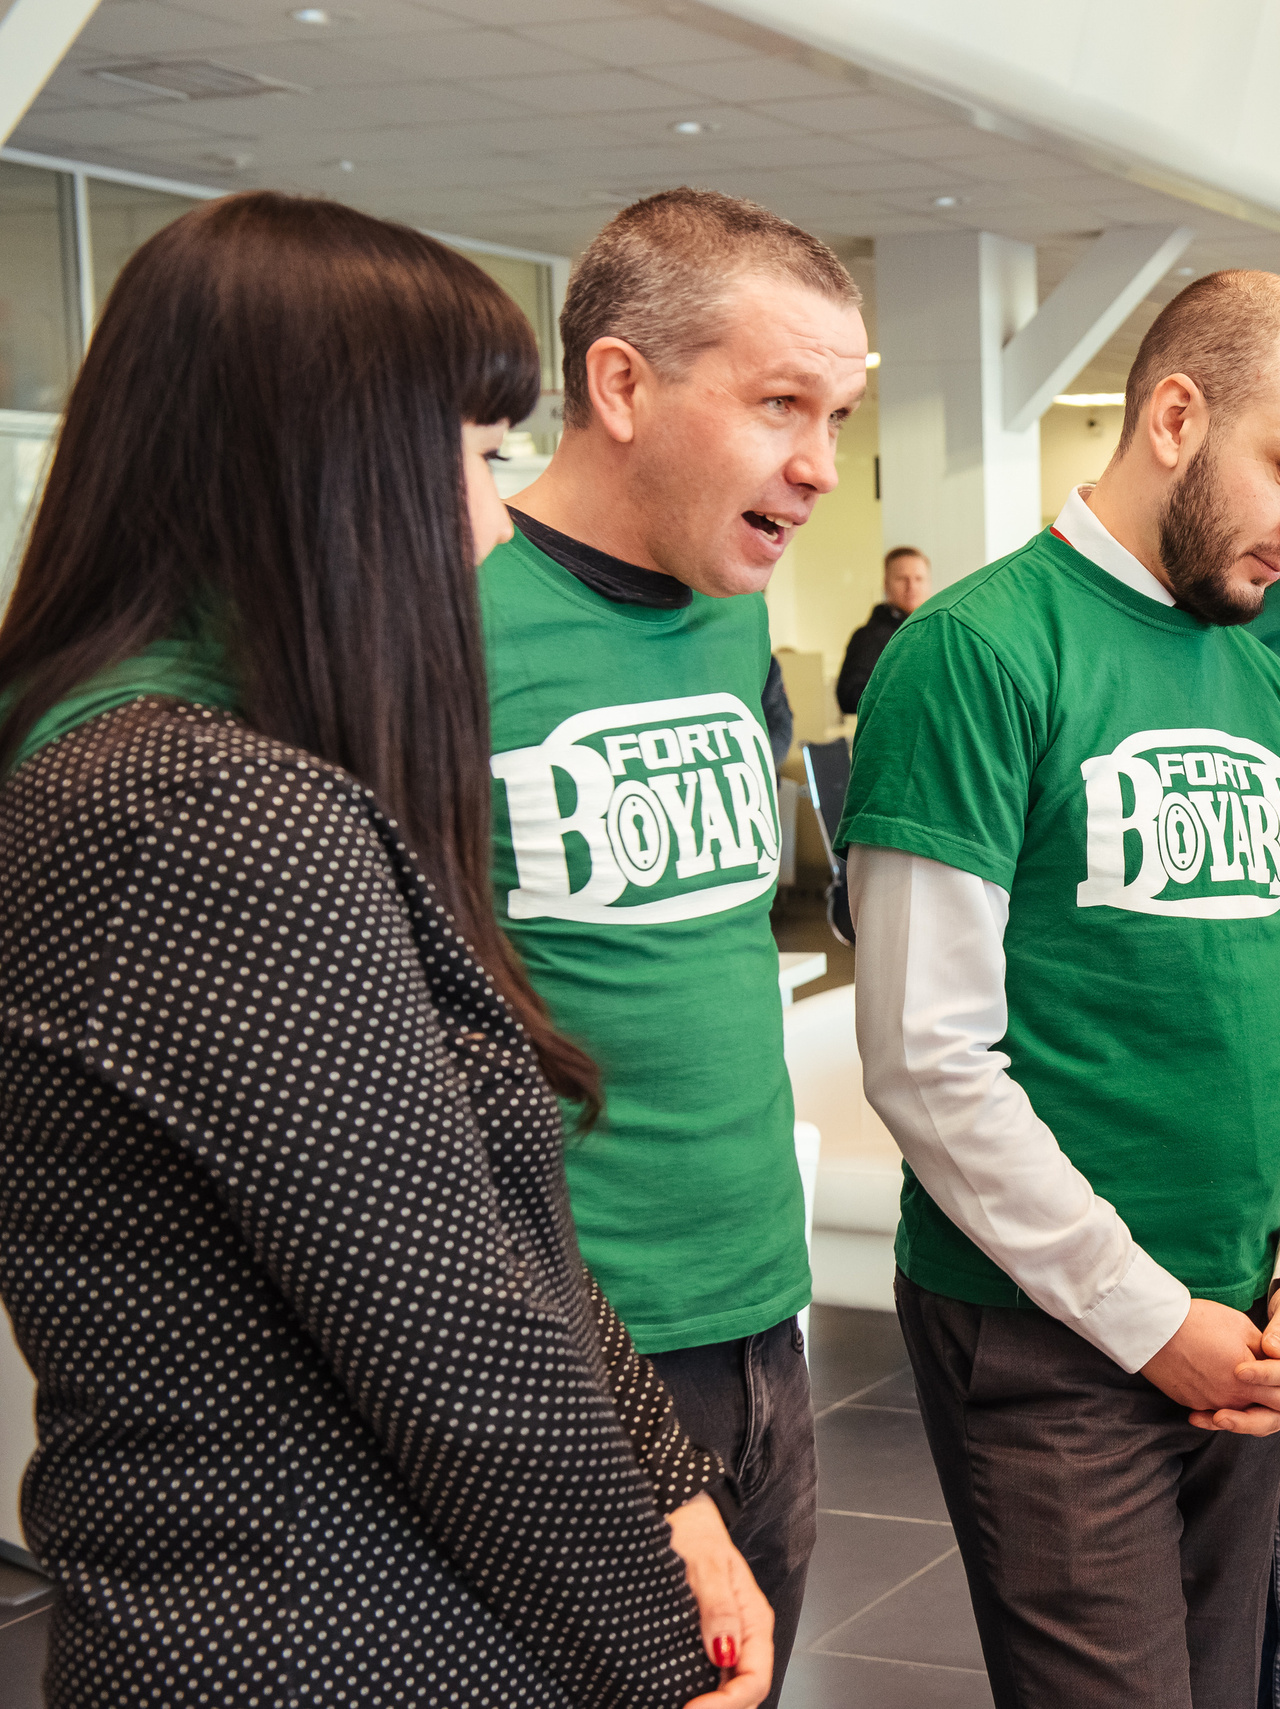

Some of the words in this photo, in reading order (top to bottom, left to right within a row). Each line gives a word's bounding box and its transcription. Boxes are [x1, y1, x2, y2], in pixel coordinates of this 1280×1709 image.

[603, 720, 732, 776] FORT
[1157, 752, 1251, 790] FORT
[489, 712, 782, 922] BOYARD
